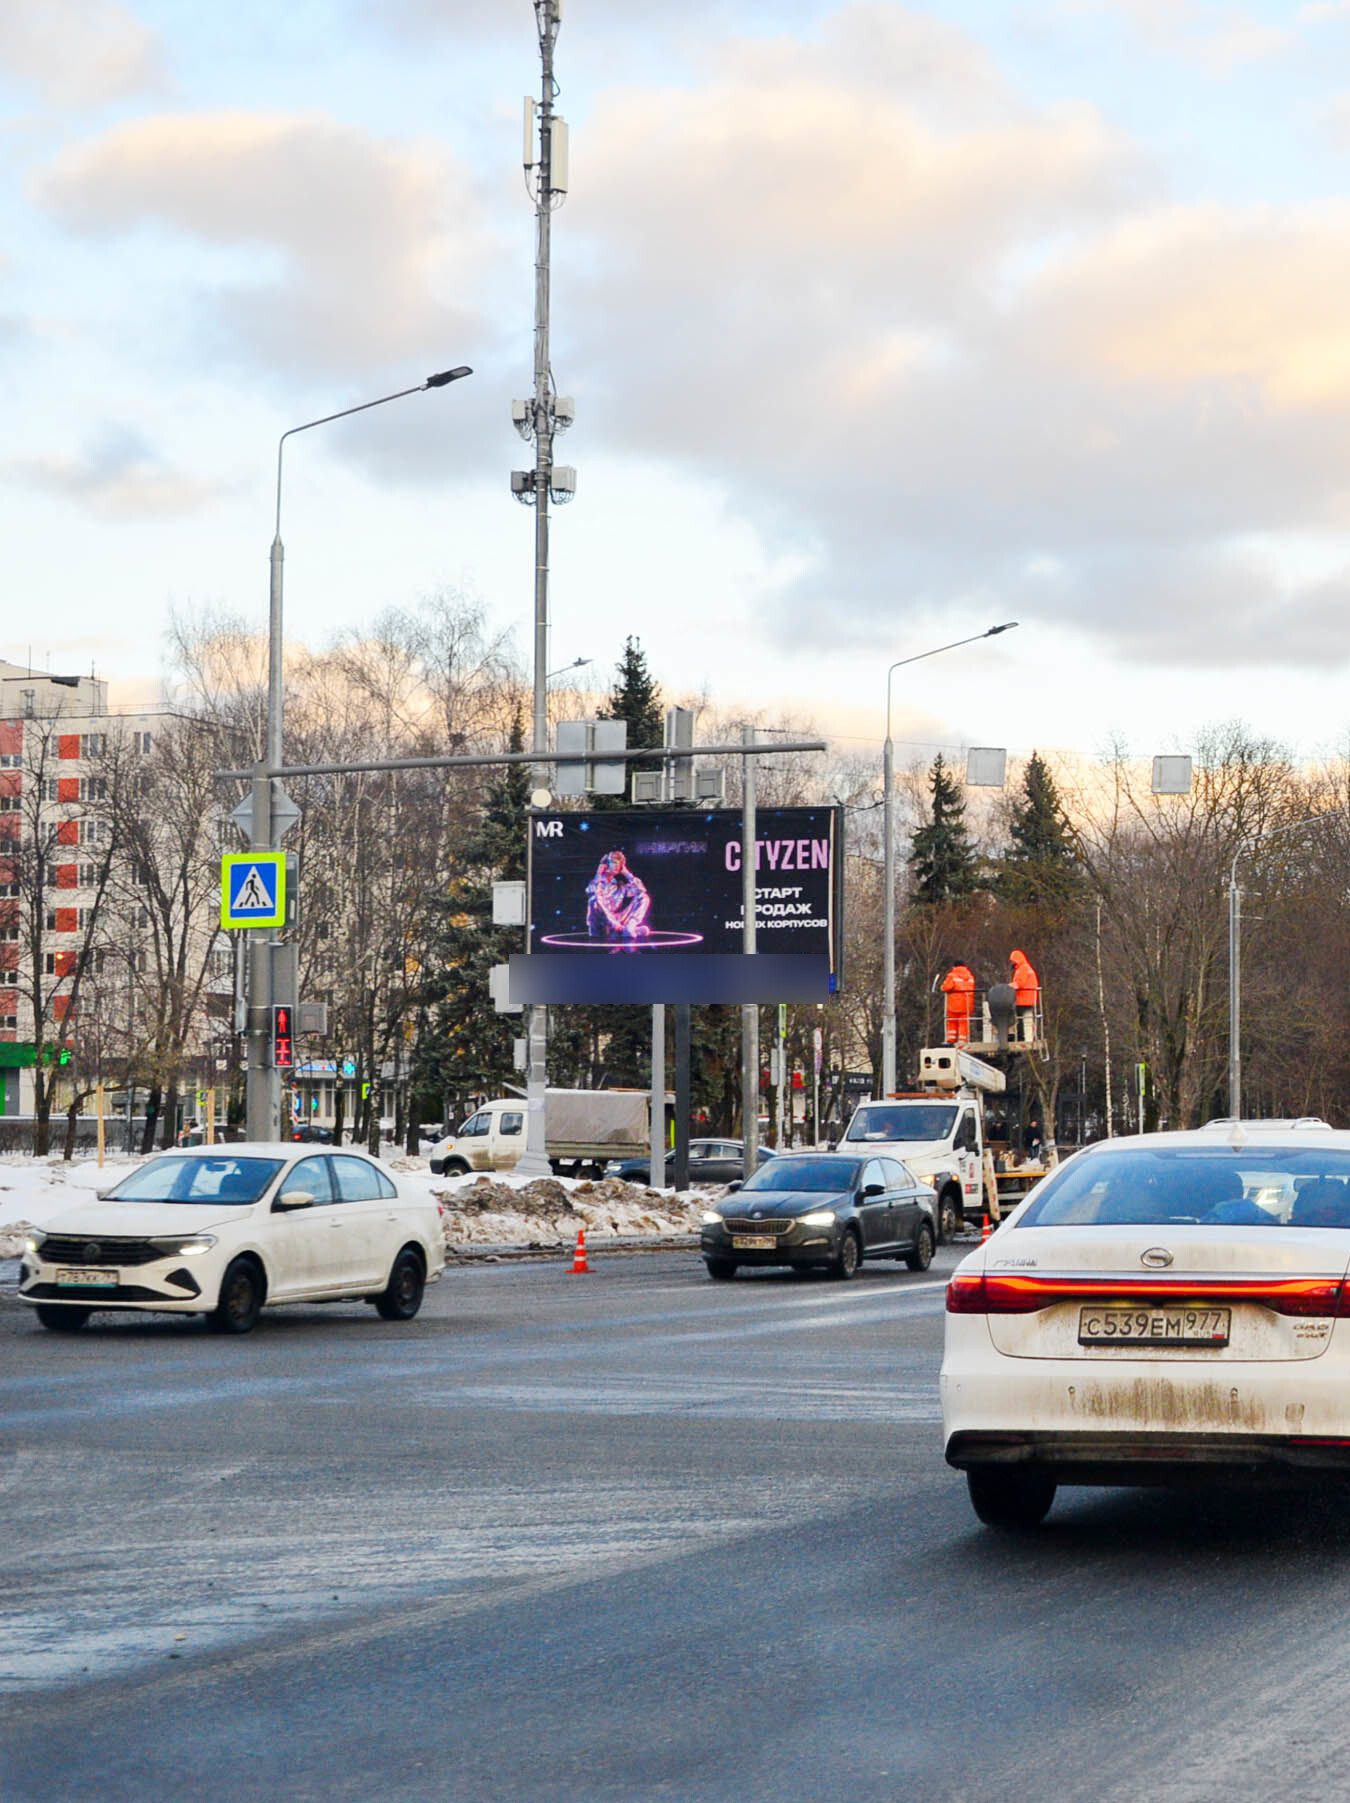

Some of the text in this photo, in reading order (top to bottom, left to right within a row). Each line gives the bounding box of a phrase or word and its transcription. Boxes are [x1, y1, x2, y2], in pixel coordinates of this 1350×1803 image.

[536, 821, 564, 837] MR
[725, 839, 829, 871] CTYZEN
[767, 919, 828, 929] КОРПУСОВ
[1186, 1311, 1222, 1331] 977
